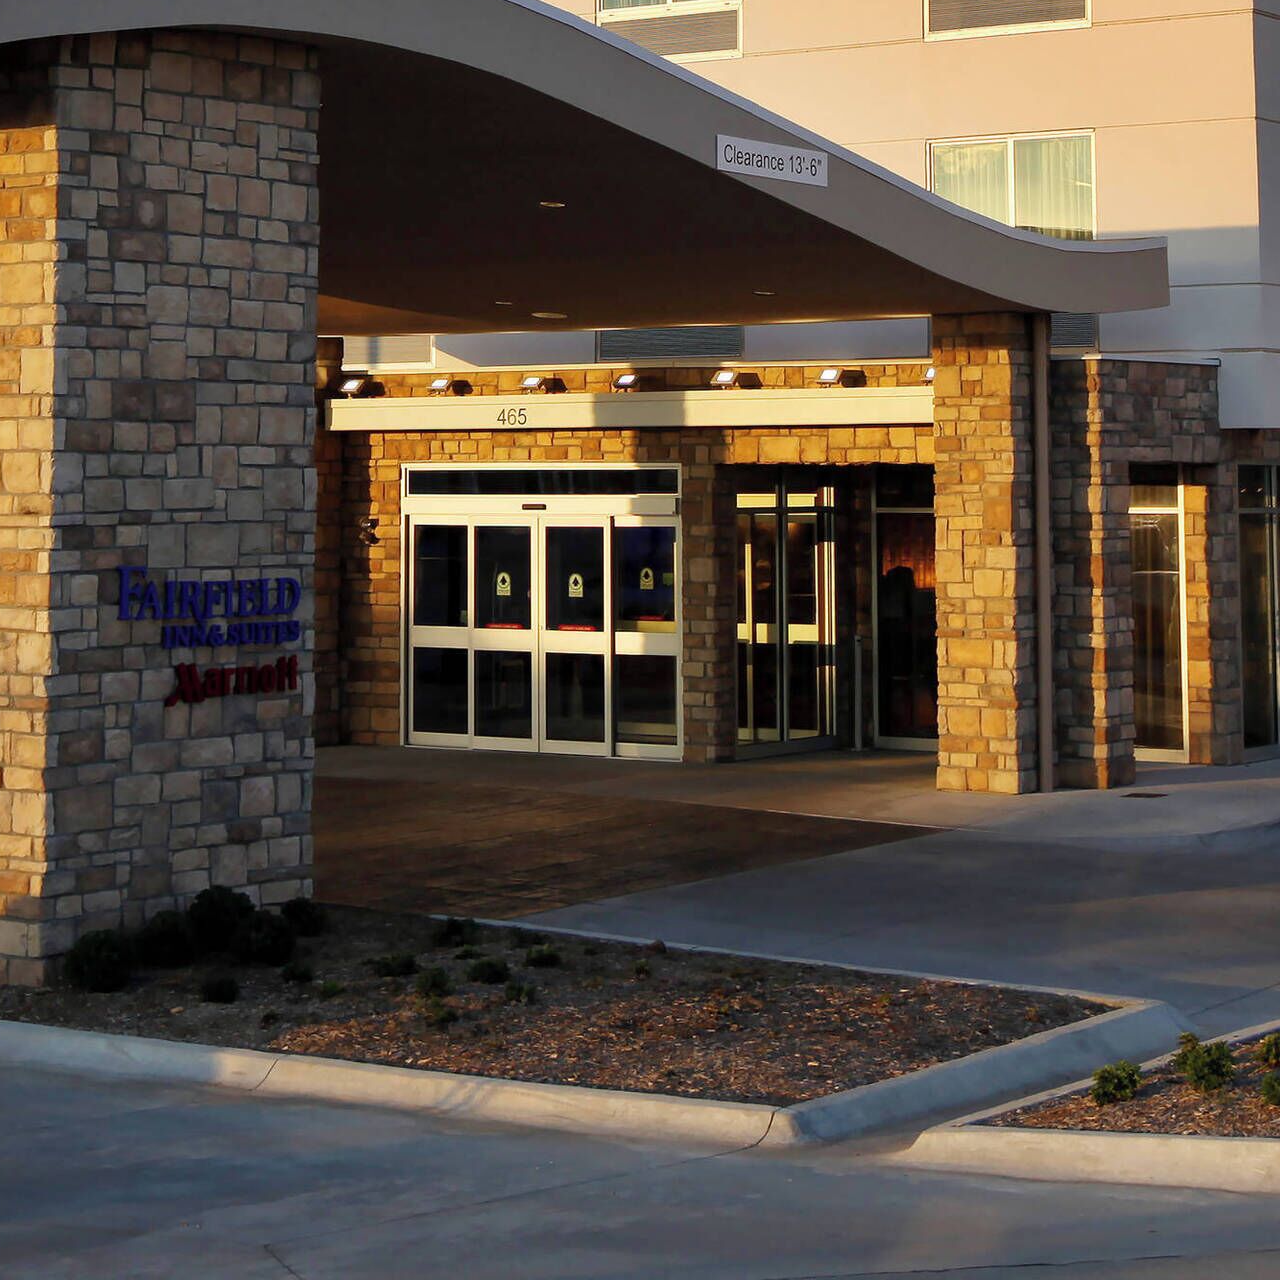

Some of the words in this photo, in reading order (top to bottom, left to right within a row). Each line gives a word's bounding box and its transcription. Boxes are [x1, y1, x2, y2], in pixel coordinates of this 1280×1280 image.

[723, 143, 785, 172] Clearance
[496, 408, 527, 426] 465
[117, 565, 302, 623] FAIRFIELD
[164, 654, 298, 708] Marriott
